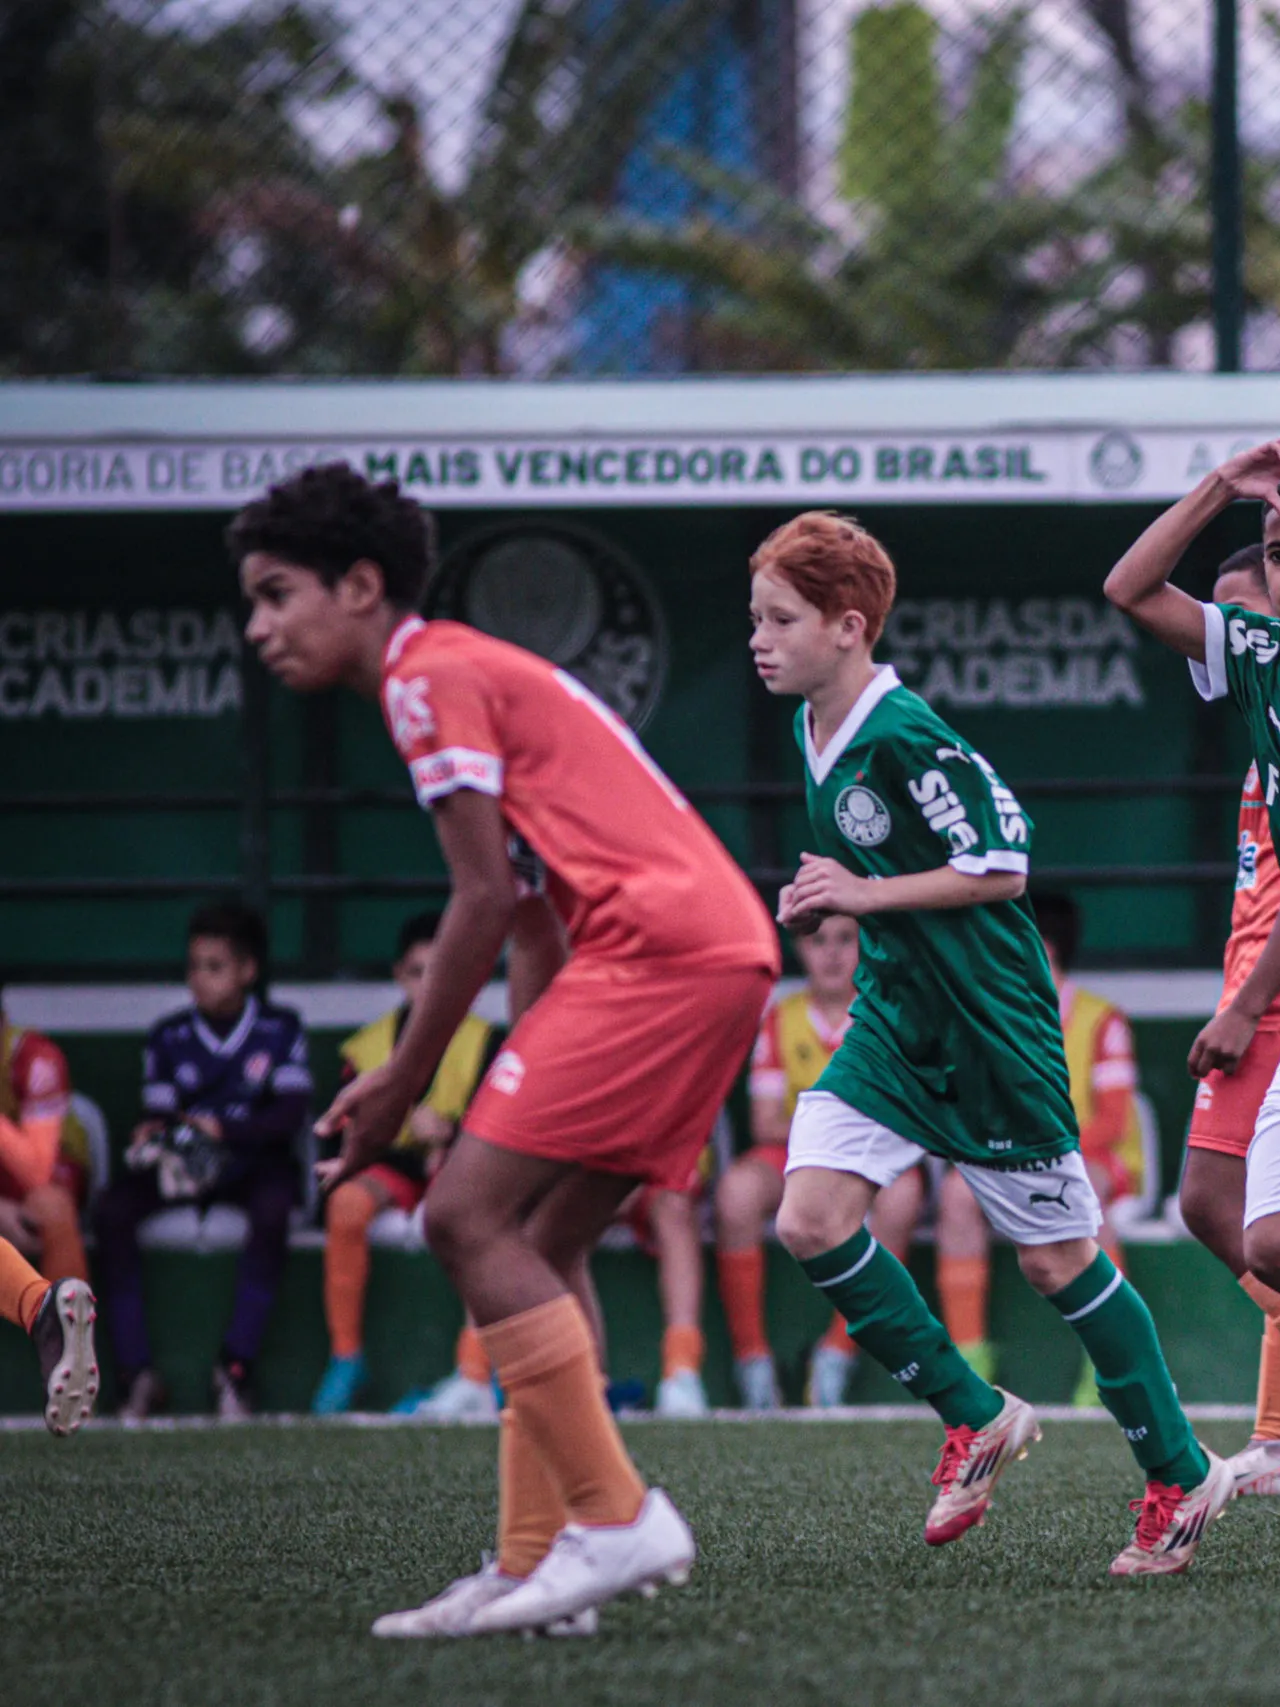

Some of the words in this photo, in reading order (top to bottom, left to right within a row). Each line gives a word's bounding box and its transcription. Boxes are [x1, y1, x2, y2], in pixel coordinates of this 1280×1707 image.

[147, 450, 206, 493] DE
[365, 450, 481, 486] MAIS
[496, 447, 784, 486] VENCEDORA
[800, 446, 862, 483] DO
[875, 444, 1047, 482] BRASIL
